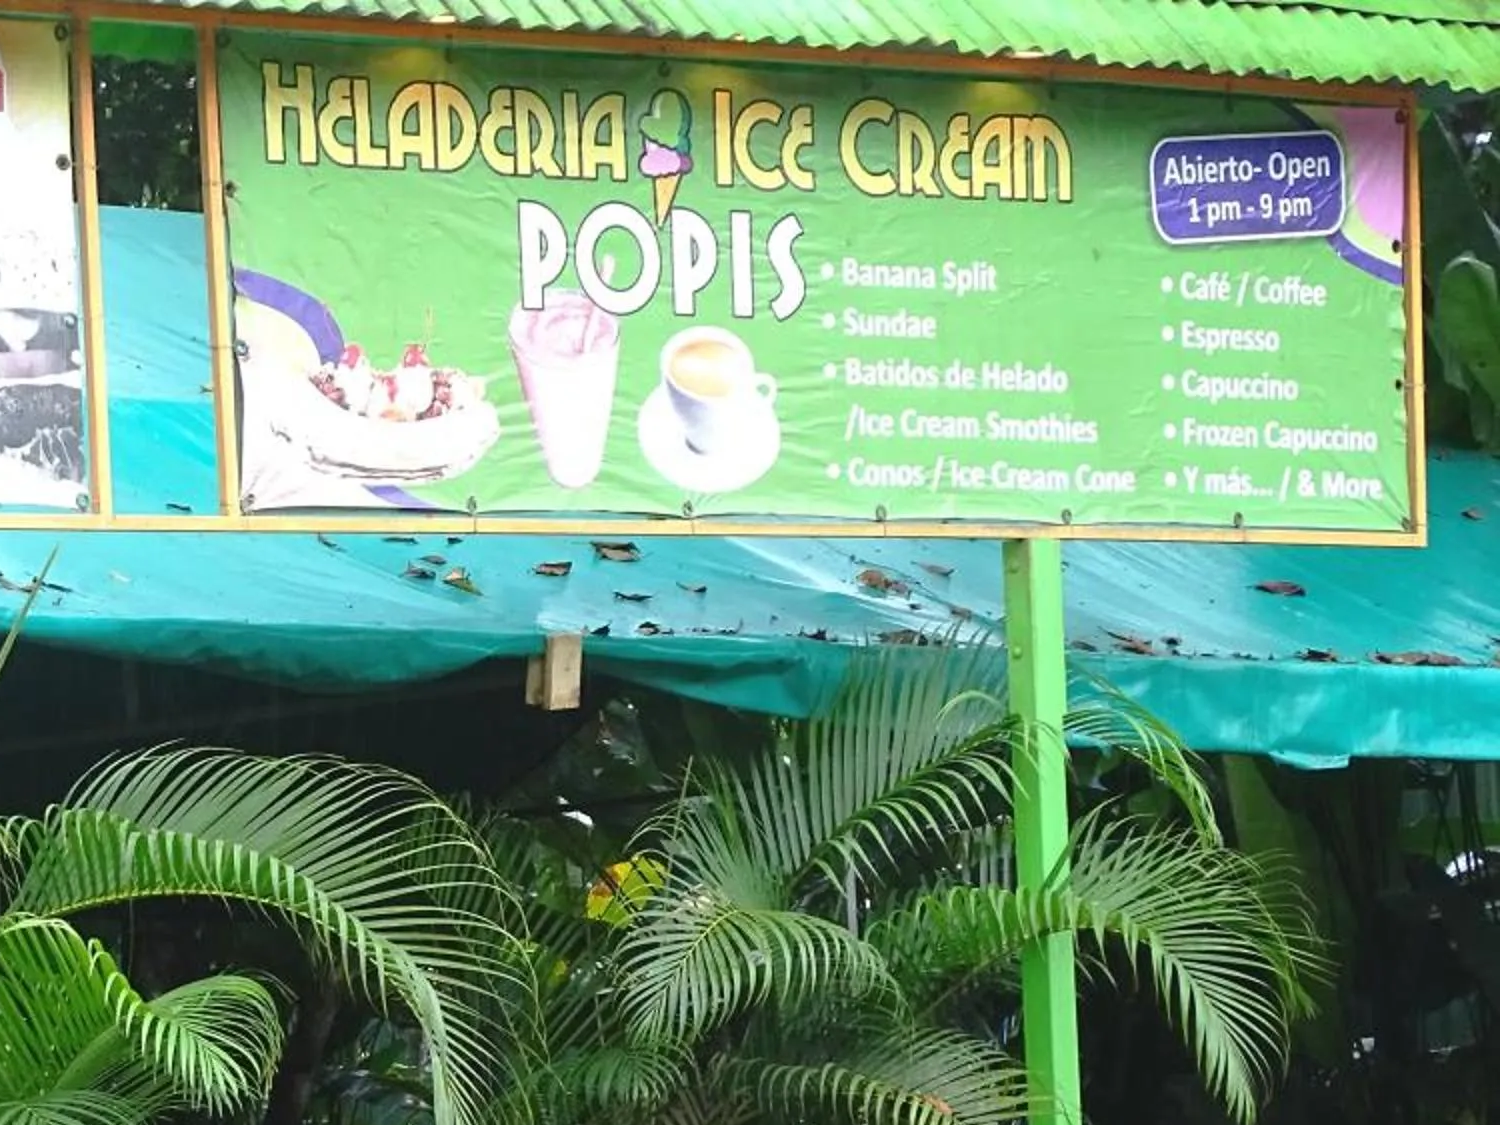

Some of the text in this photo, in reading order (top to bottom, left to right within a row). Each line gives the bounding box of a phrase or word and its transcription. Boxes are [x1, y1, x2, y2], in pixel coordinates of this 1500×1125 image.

[262, 59, 1072, 203] HELADERIA ICE CREAM
[1268, 151, 1331, 185] Open
[1188, 198, 1201, 223] 1
[1207, 200, 1241, 228] pm
[1259, 193, 1273, 219] 9
[1280, 195, 1312, 224] pm
[518, 200, 807, 322] POPIS
[842, 257, 997, 297] Banana Split
[1179, 271, 1230, 300] Café
[1253, 275, 1327, 307] Coffee
[843, 307, 936, 338] Sundae
[1180, 320, 1280, 356] Espresso
[845, 357, 1069, 393] Batidos de Helado
[1181, 368, 1299, 405] Capuccino
[900, 407, 979, 438] Cream
[985, 410, 1098, 444] Smothies
[1183, 417, 1378, 456] Frozen Capuccino
[848, 456, 924, 488] Conos
[949, 458, 986, 489] Ice
[991, 460, 1069, 492] Cream
[1074, 463, 1136, 493] Cone
[1183, 465, 1199, 494] Y
[1297, 469, 1316, 496] &
[1322, 471, 1383, 500] More
